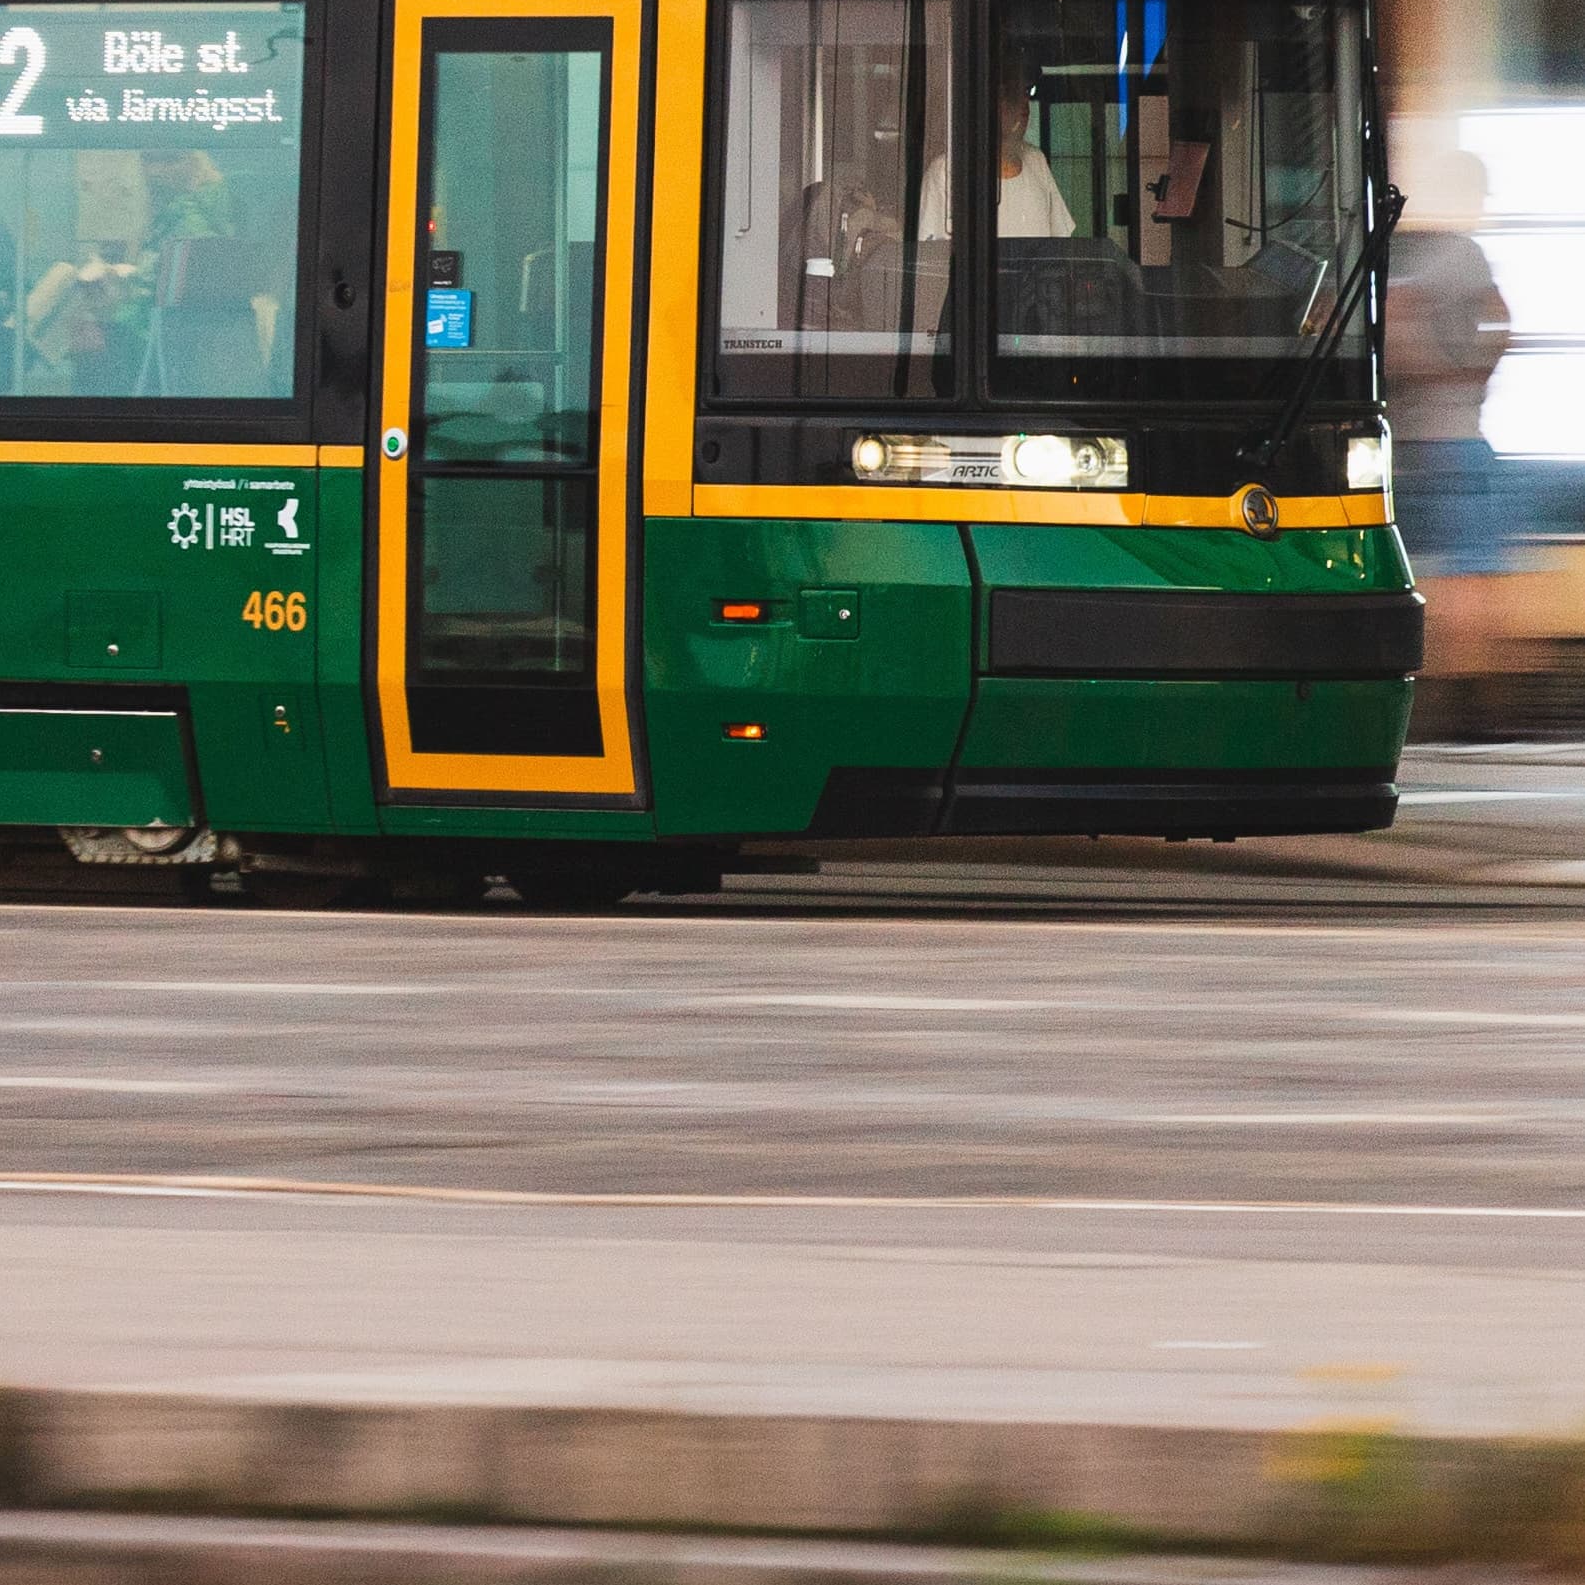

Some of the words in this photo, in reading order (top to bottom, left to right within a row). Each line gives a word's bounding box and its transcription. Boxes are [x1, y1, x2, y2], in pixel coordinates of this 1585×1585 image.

[103, 31, 184, 73] Böle
[197, 31, 248, 73] st.
[66, 89, 110, 121] via
[724, 339, 783, 349] TRANSTECH
[220, 507, 255, 527] HSL
[220, 527, 255, 547] HRT
[242, 590, 307, 631] 466
